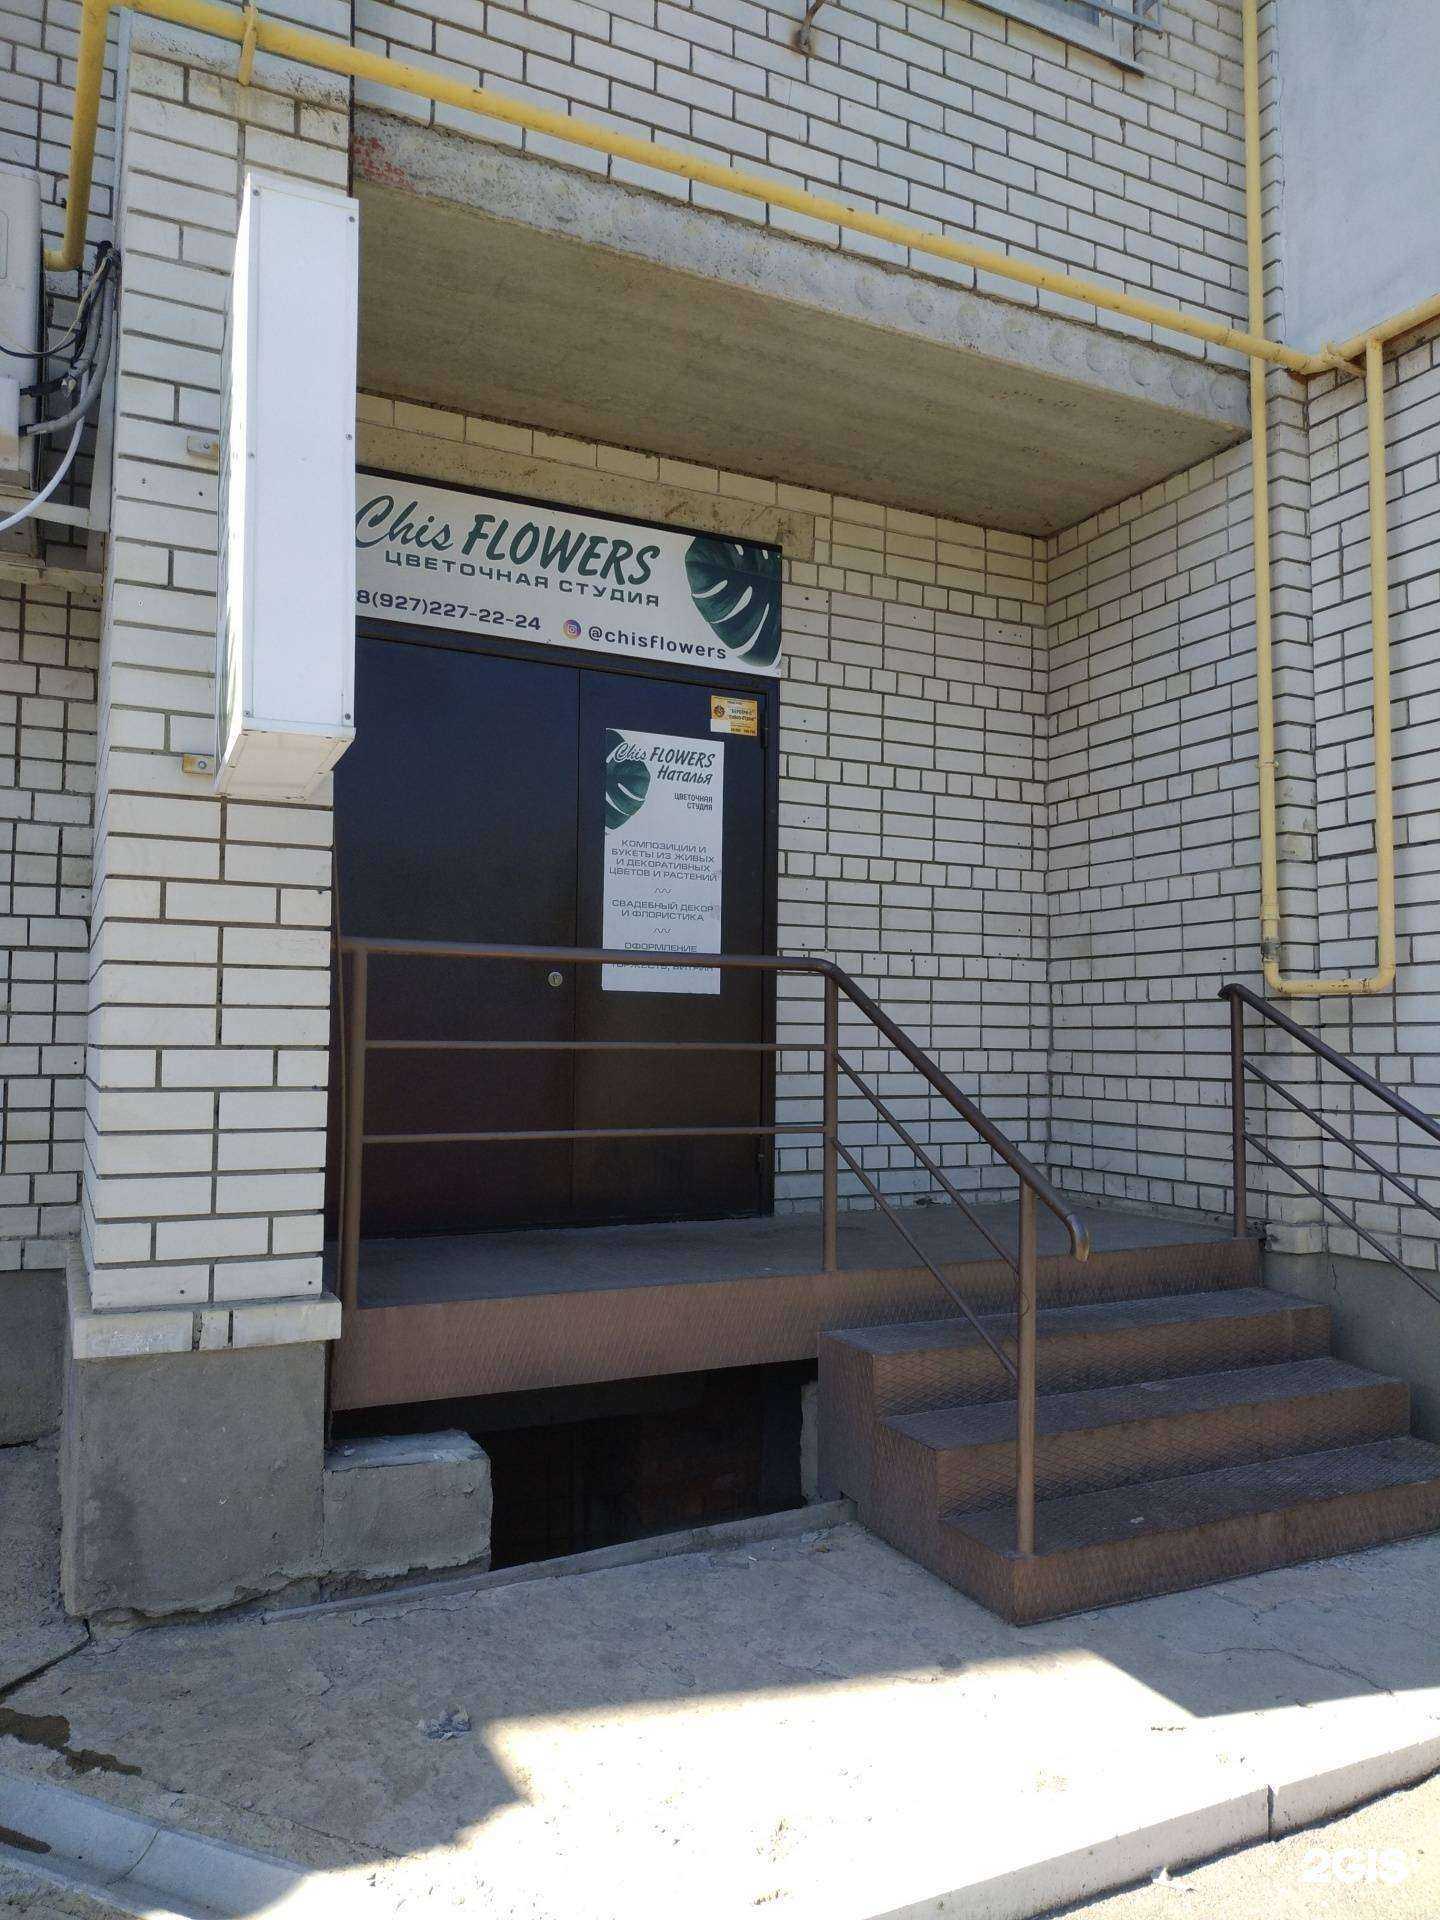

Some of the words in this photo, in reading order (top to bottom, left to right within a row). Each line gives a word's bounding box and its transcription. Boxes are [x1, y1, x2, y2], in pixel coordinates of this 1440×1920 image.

[355, 495, 453, 551] Chis
[462, 513, 660, 586] FLOWERS
[385, 550, 549, 589] ЦВЕТОЧНАЯ
[558, 579, 660, 608] СТУДИЯ
[356, 589, 541, 631] 8(927)227-22-24
[588, 626, 727, 660] @chisflowers
[614, 742, 648, 762] Chis
[649, 747, 716, 768] FLOWERS
[657, 765, 713, 785] Наталья
[674, 792, 713, 804] ЦВЕТОЧНАЯ
[687, 802, 713, 811] СТУДИЯ
[621, 839, 696, 853] КОМПОЗИЦИИ
[699, 846, 707, 854] И
[611, 848, 654, 858] БУКЕТЫ
[656, 852, 672, 860] ИЗ
[674, 854, 715, 863] ЖИВЫХ
[616, 858, 625, 866] И
[626, 859, 710, 872] ДЕКОРАТИВНЫХ
[609, 867, 650, 877] ЦВЕТОВ
[653, 870, 661, 878] И
[663, 871, 718, 882] РАСТЕНИЙ
[611, 899, 678, 910] СВАДЕБНЫЙ
[680, 904, 714, 913] ДЕКОР
[621, 909, 630, 917] И
[632, 910, 704, 922] ФЛОРИСТИКА
[624, 942, 698, 953] ОФОРМЛЕНИЕ
